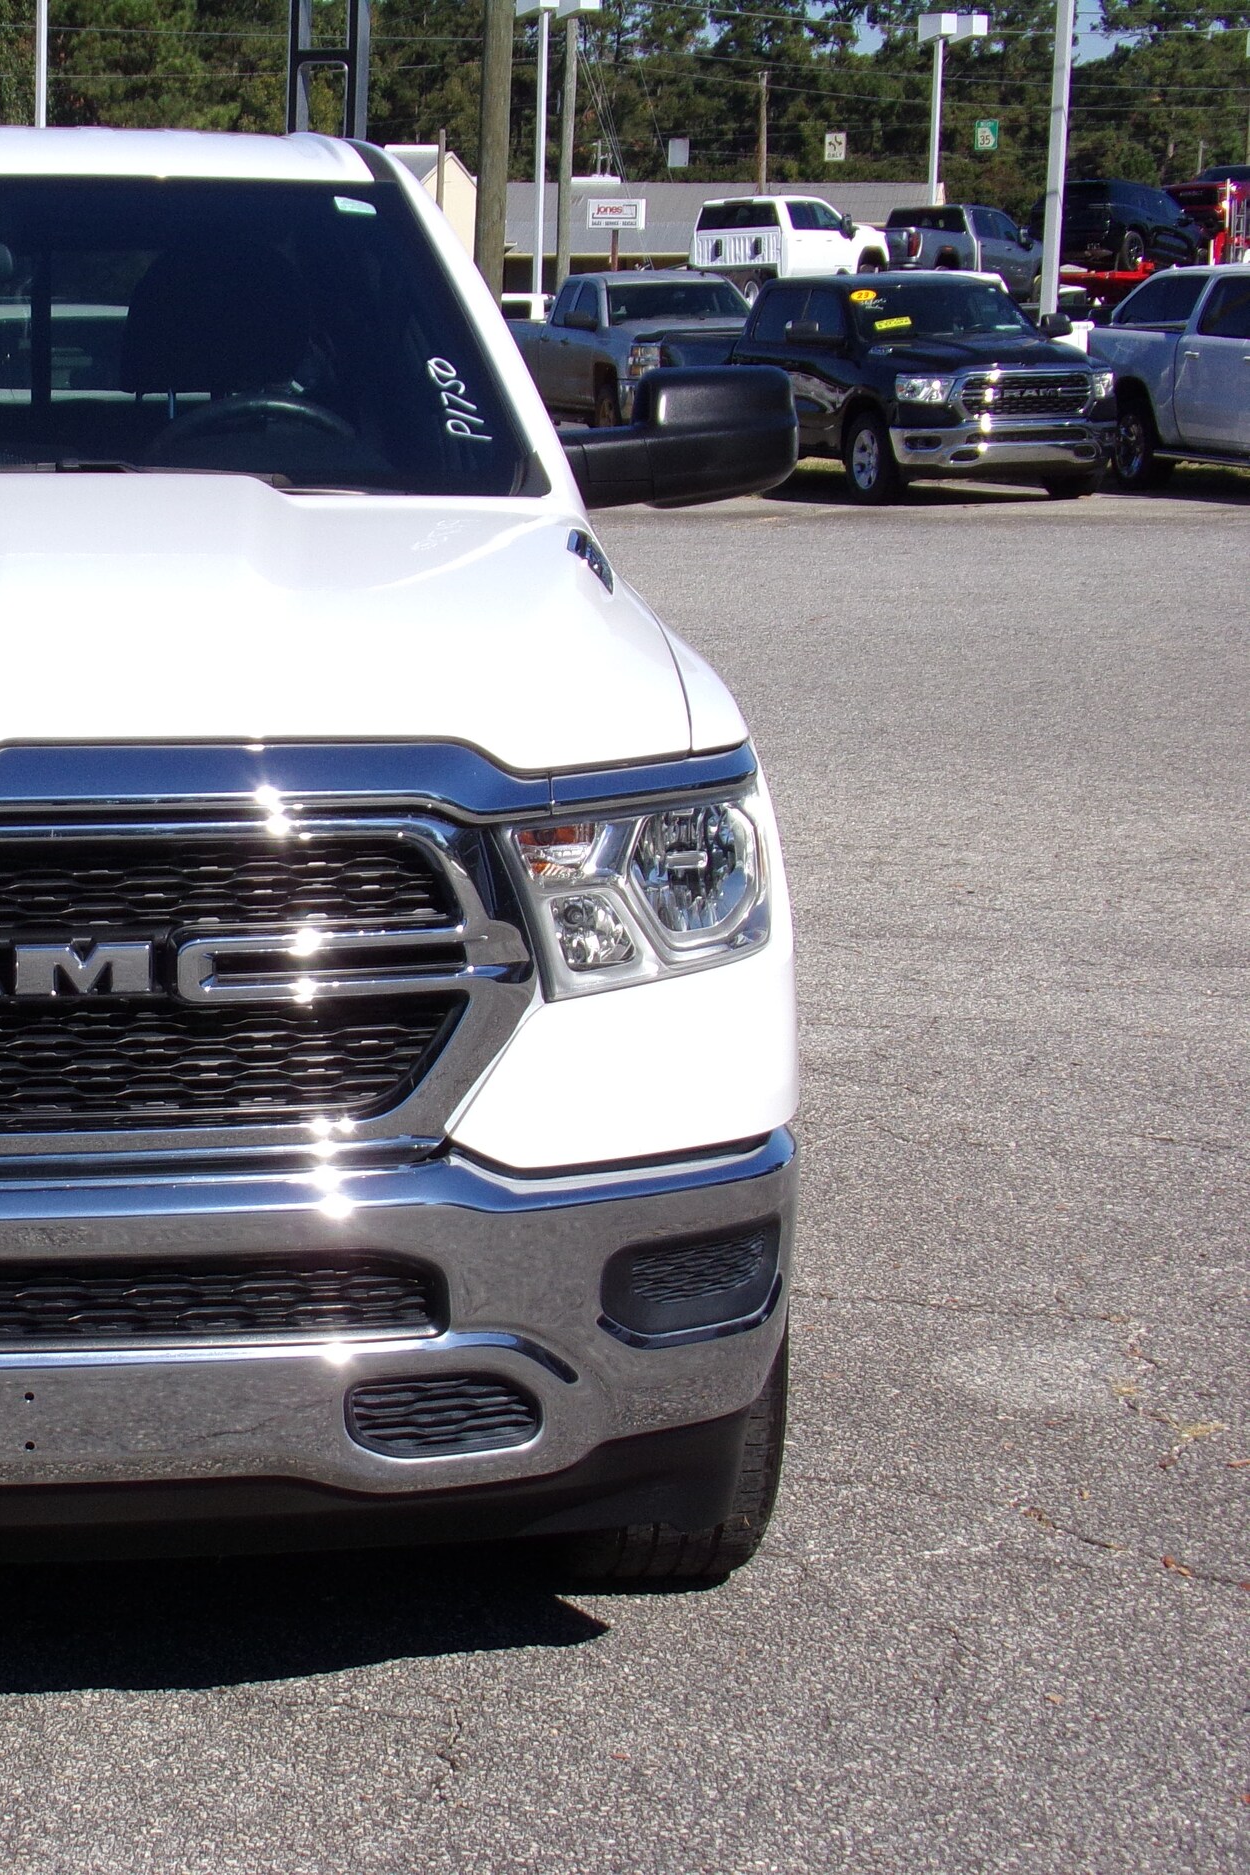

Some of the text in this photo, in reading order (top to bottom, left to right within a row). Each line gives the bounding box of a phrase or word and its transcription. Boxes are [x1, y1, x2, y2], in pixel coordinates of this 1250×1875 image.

[979, 134, 991, 146] 35
[596, 203, 623, 215] jones
[856, 291, 870, 299] 23
[1003, 388, 1057, 398] RAM
